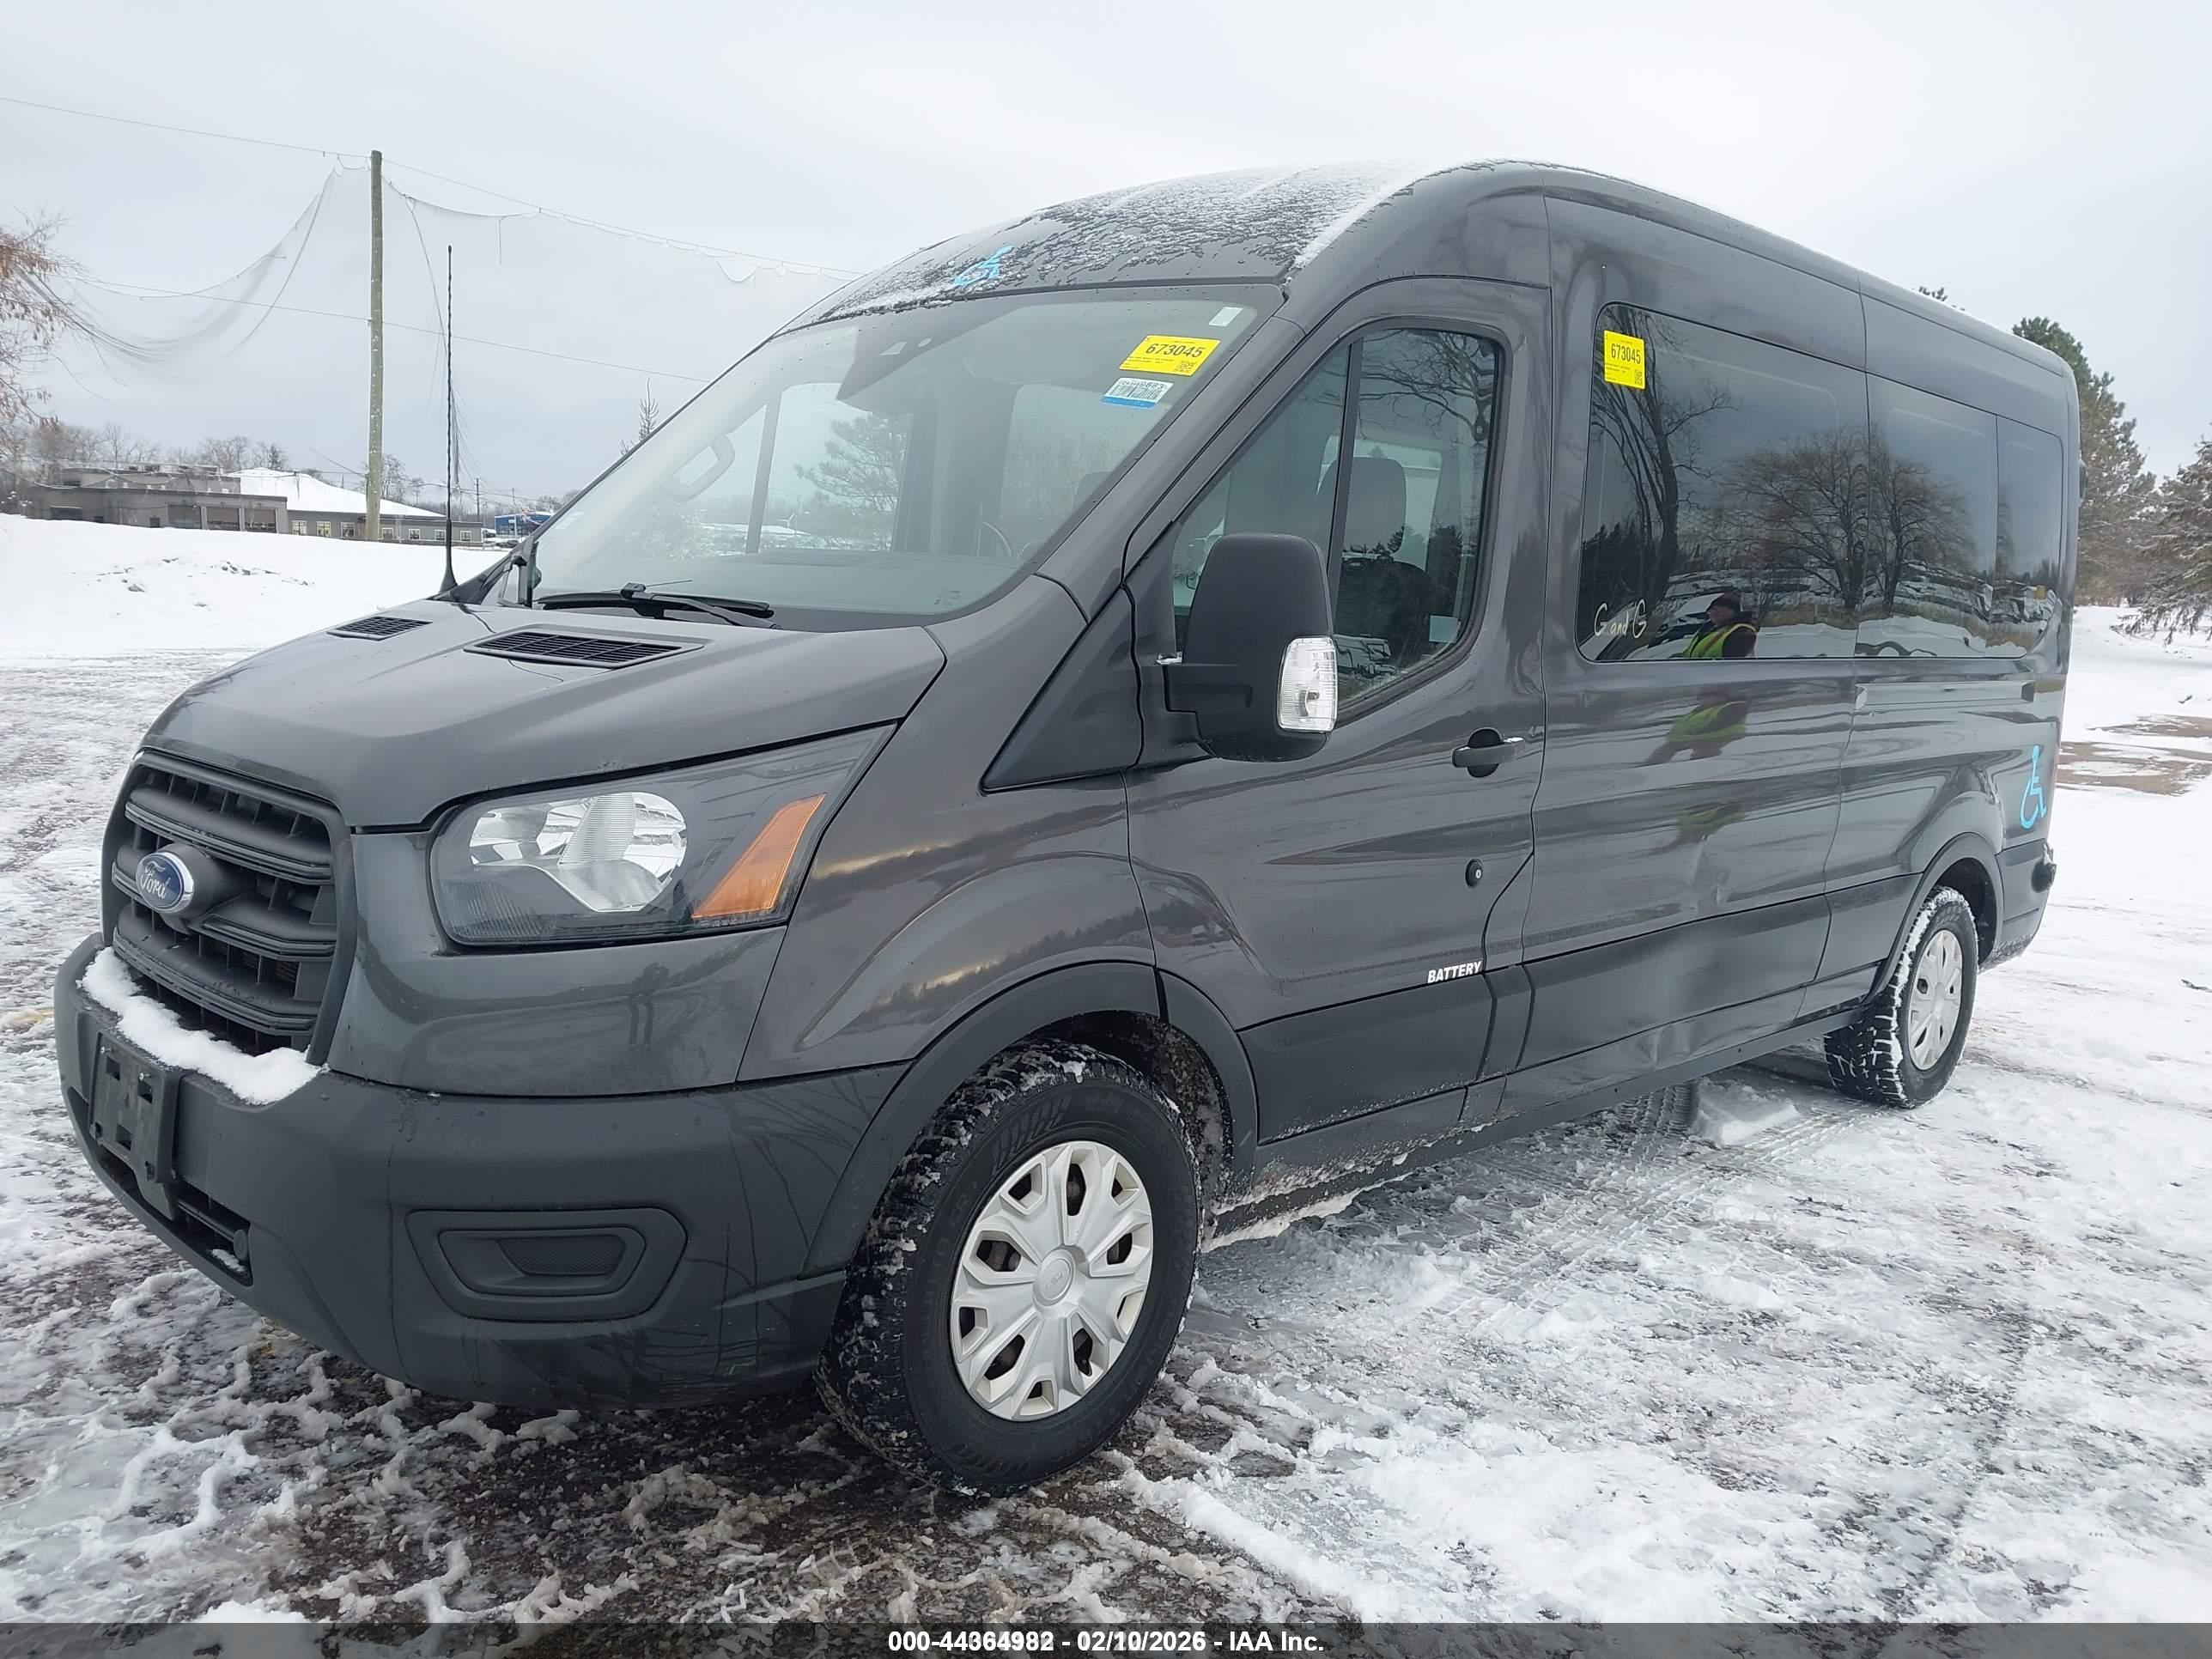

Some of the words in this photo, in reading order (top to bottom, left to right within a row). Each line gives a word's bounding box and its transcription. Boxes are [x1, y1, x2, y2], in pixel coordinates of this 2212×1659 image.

[1146, 343, 1205, 358] 673045
[1611, 343, 1641, 364] 673045
[1594, 603, 1607, 637] G
[1610, 611, 1629, 635] and
[1632, 599, 1648, 639] G
[141, 861, 171, 900] Ford
[1427, 961, 1483, 984] BATTERY
